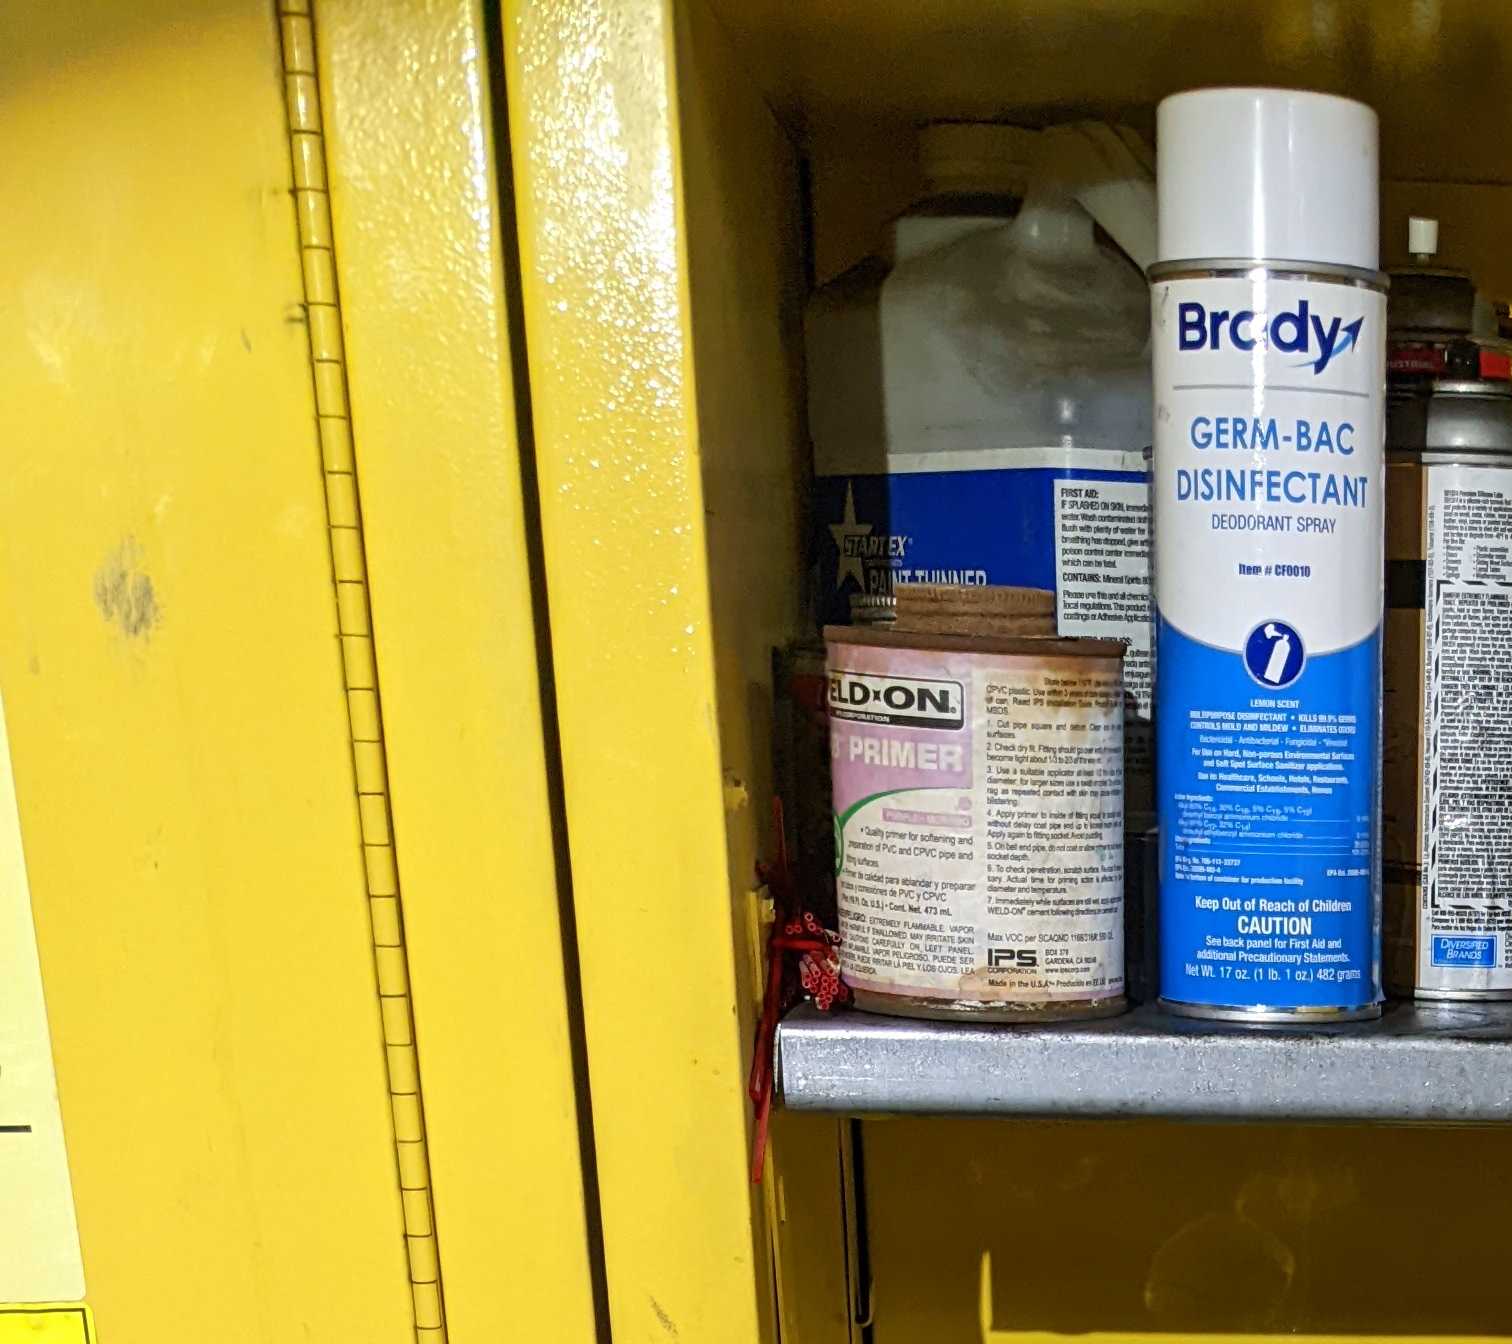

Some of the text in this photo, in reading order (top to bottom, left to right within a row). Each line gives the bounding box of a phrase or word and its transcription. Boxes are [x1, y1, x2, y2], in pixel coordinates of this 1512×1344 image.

[1179, 300, 1342, 375] Brady
[1191, 417, 1355, 455] GERM-BAC
[1177, 469, 1367, 507] DISINFECTANT
[1212, 514, 1336, 533] DEODORANT SPRAY
[849, 736, 963, 771] PRIMER
[1195, 896, 1218, 911] Keep
[1223, 897, 1241, 910] Out
[1244, 898, 1256, 910] of
[1260, 899, 1295, 912] Reach
[1299, 900, 1309, 912] of
[1238, 916, 1312, 935] CAUTION
[987, 949, 1037, 967] IPS
